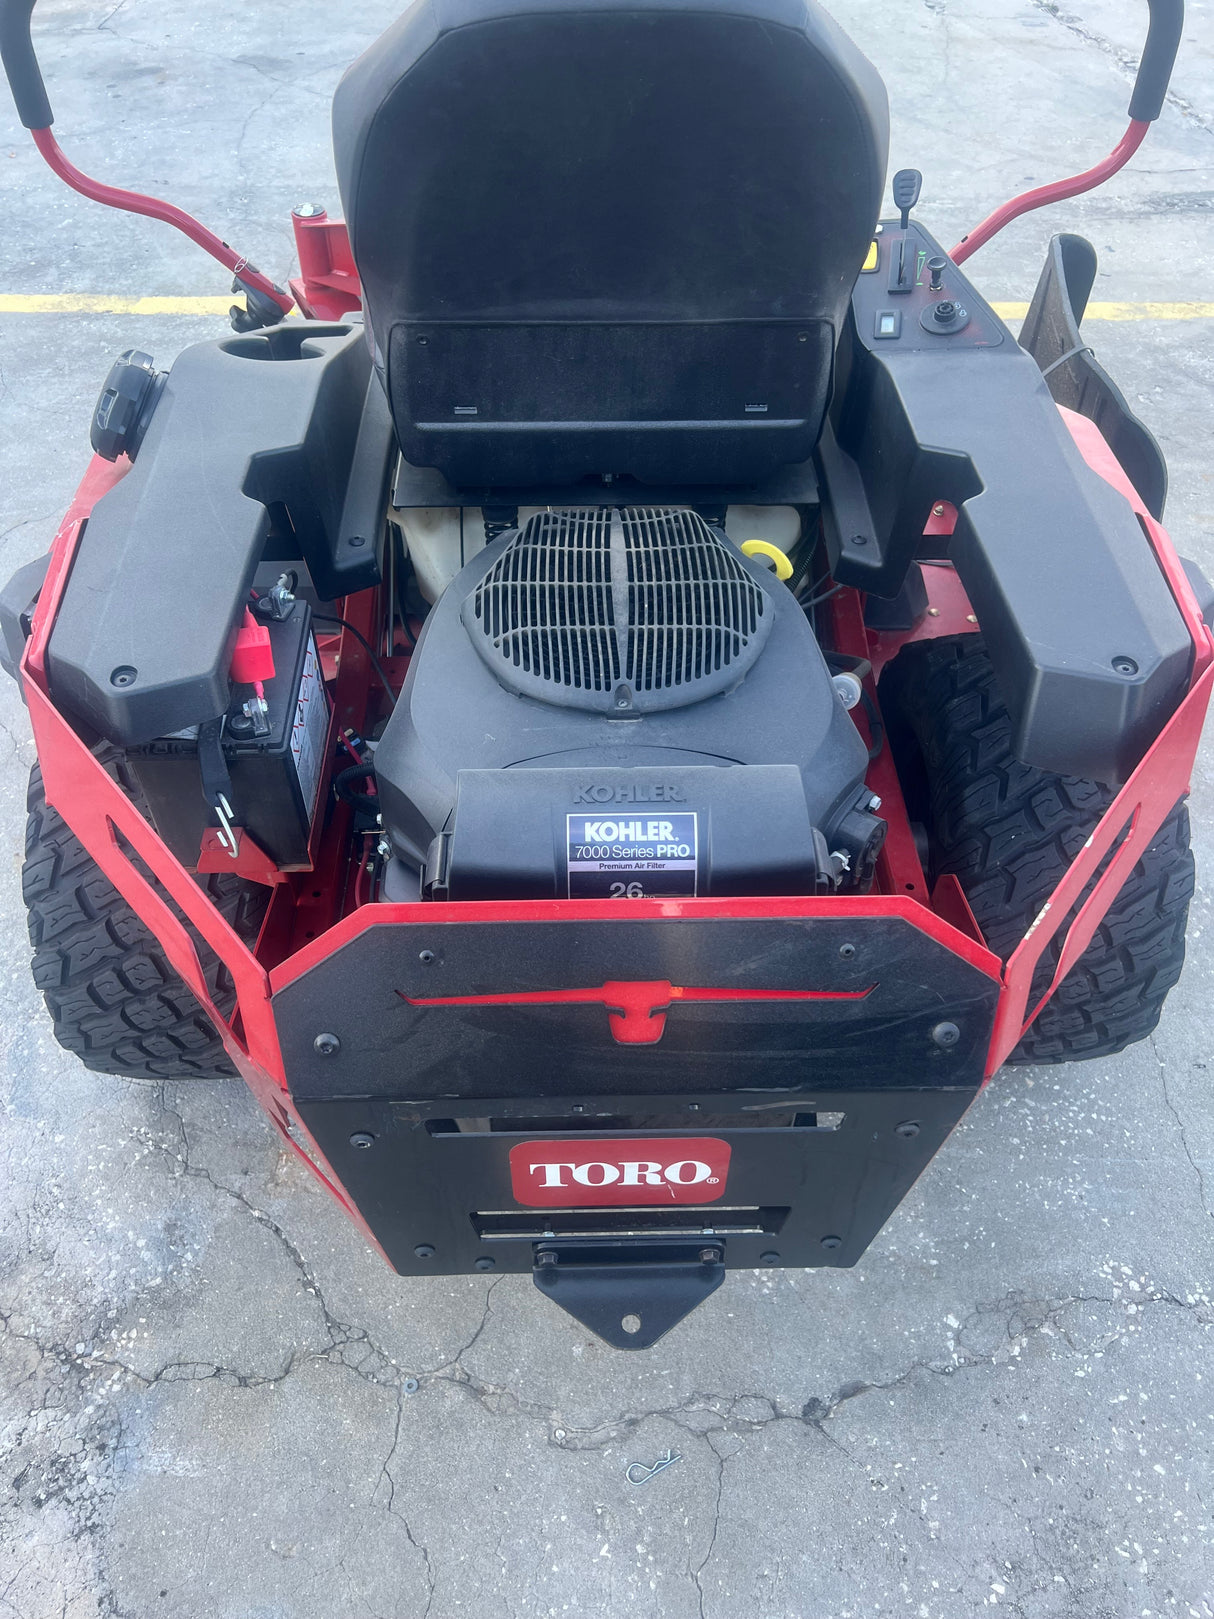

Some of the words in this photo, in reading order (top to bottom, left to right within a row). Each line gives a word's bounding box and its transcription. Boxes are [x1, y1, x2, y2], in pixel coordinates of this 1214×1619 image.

[575, 845, 610, 859] 7000
[612, 845, 654, 858] Series
[656, 844, 690, 858] PRO
[609, 881, 644, 899] 26
